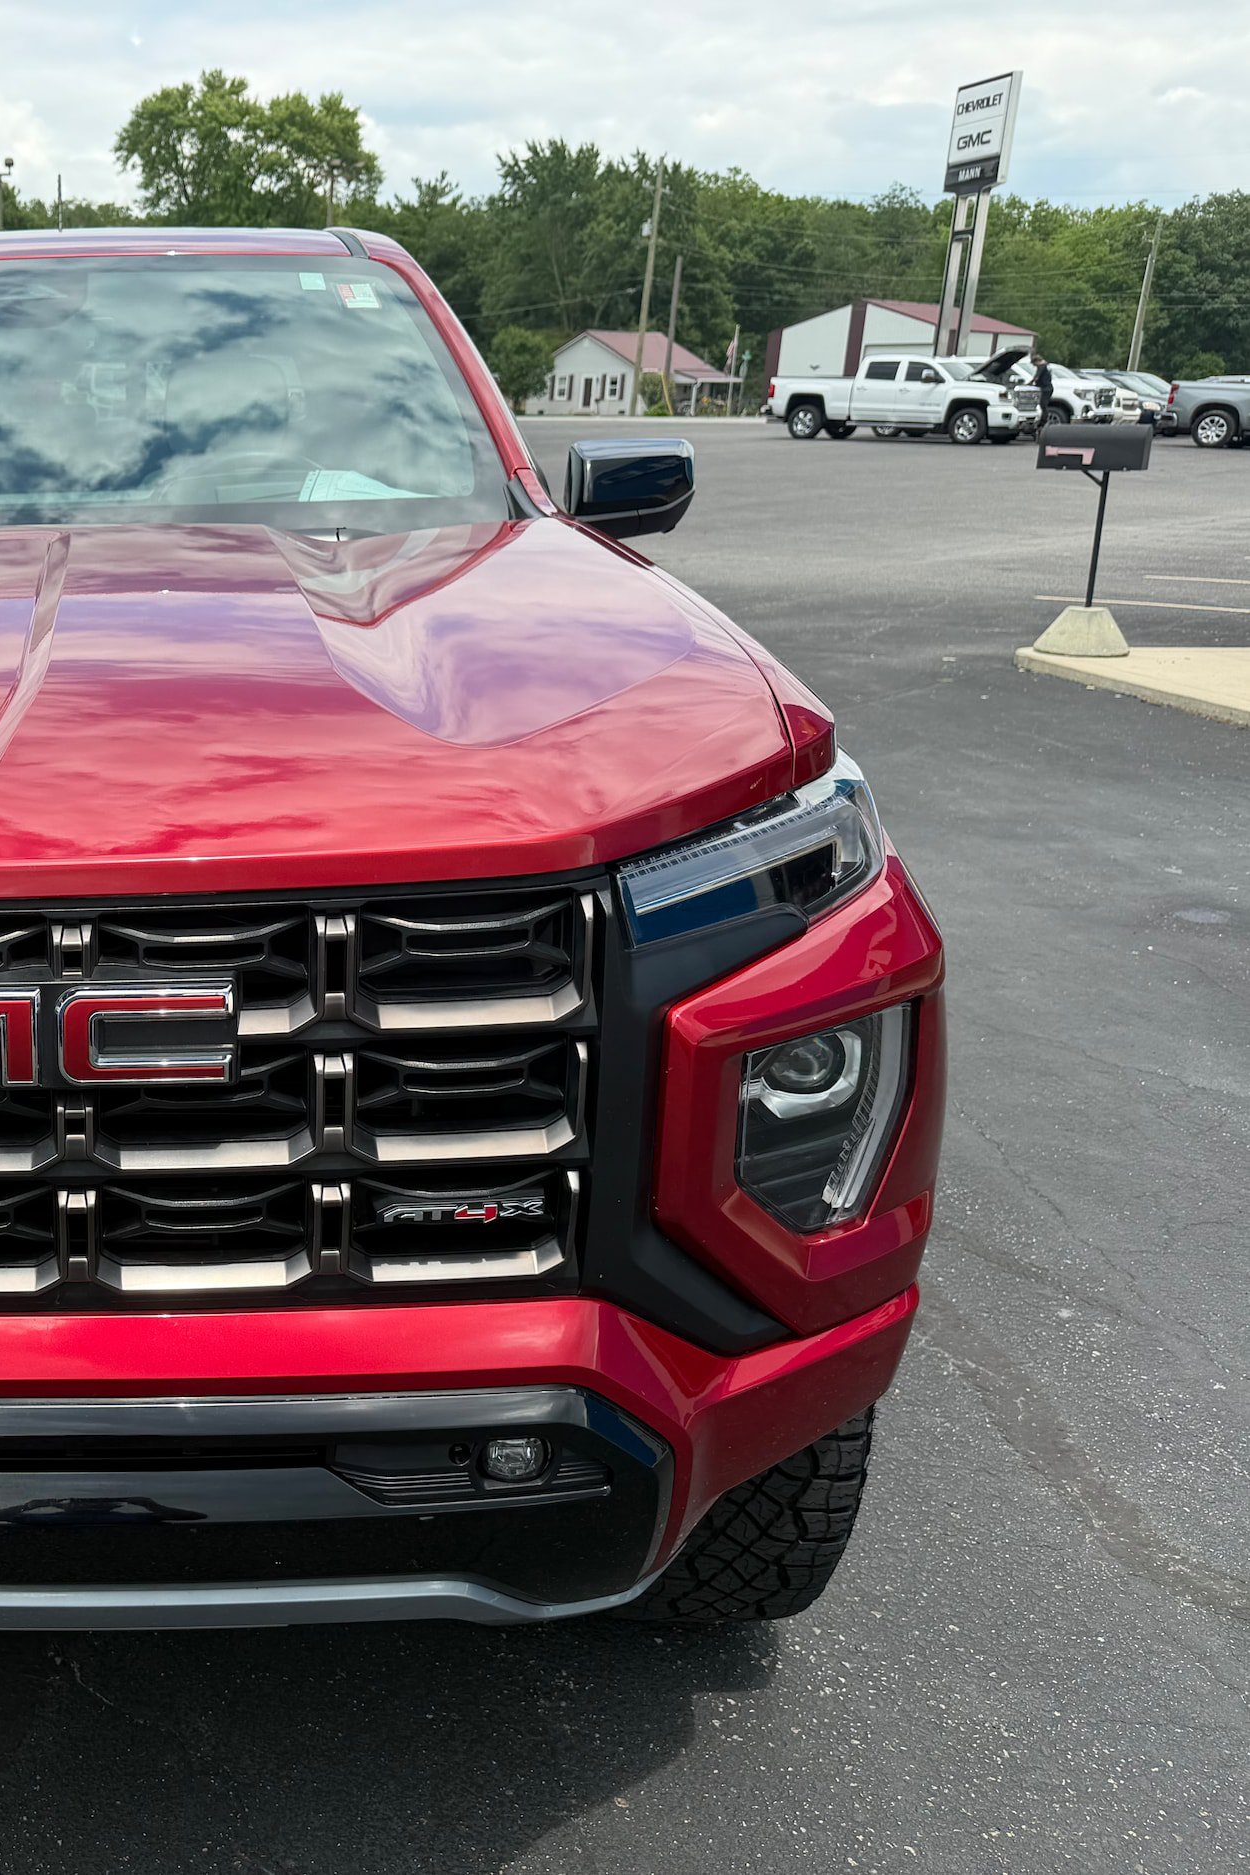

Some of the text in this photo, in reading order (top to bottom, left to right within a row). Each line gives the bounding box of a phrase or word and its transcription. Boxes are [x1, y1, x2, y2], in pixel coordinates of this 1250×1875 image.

[956, 93, 1004, 116] CHEVROLET
[957, 130, 992, 150] GMC
[958, 166, 981, 182] MANN
[379, 1200, 546, 1224] AT4X
